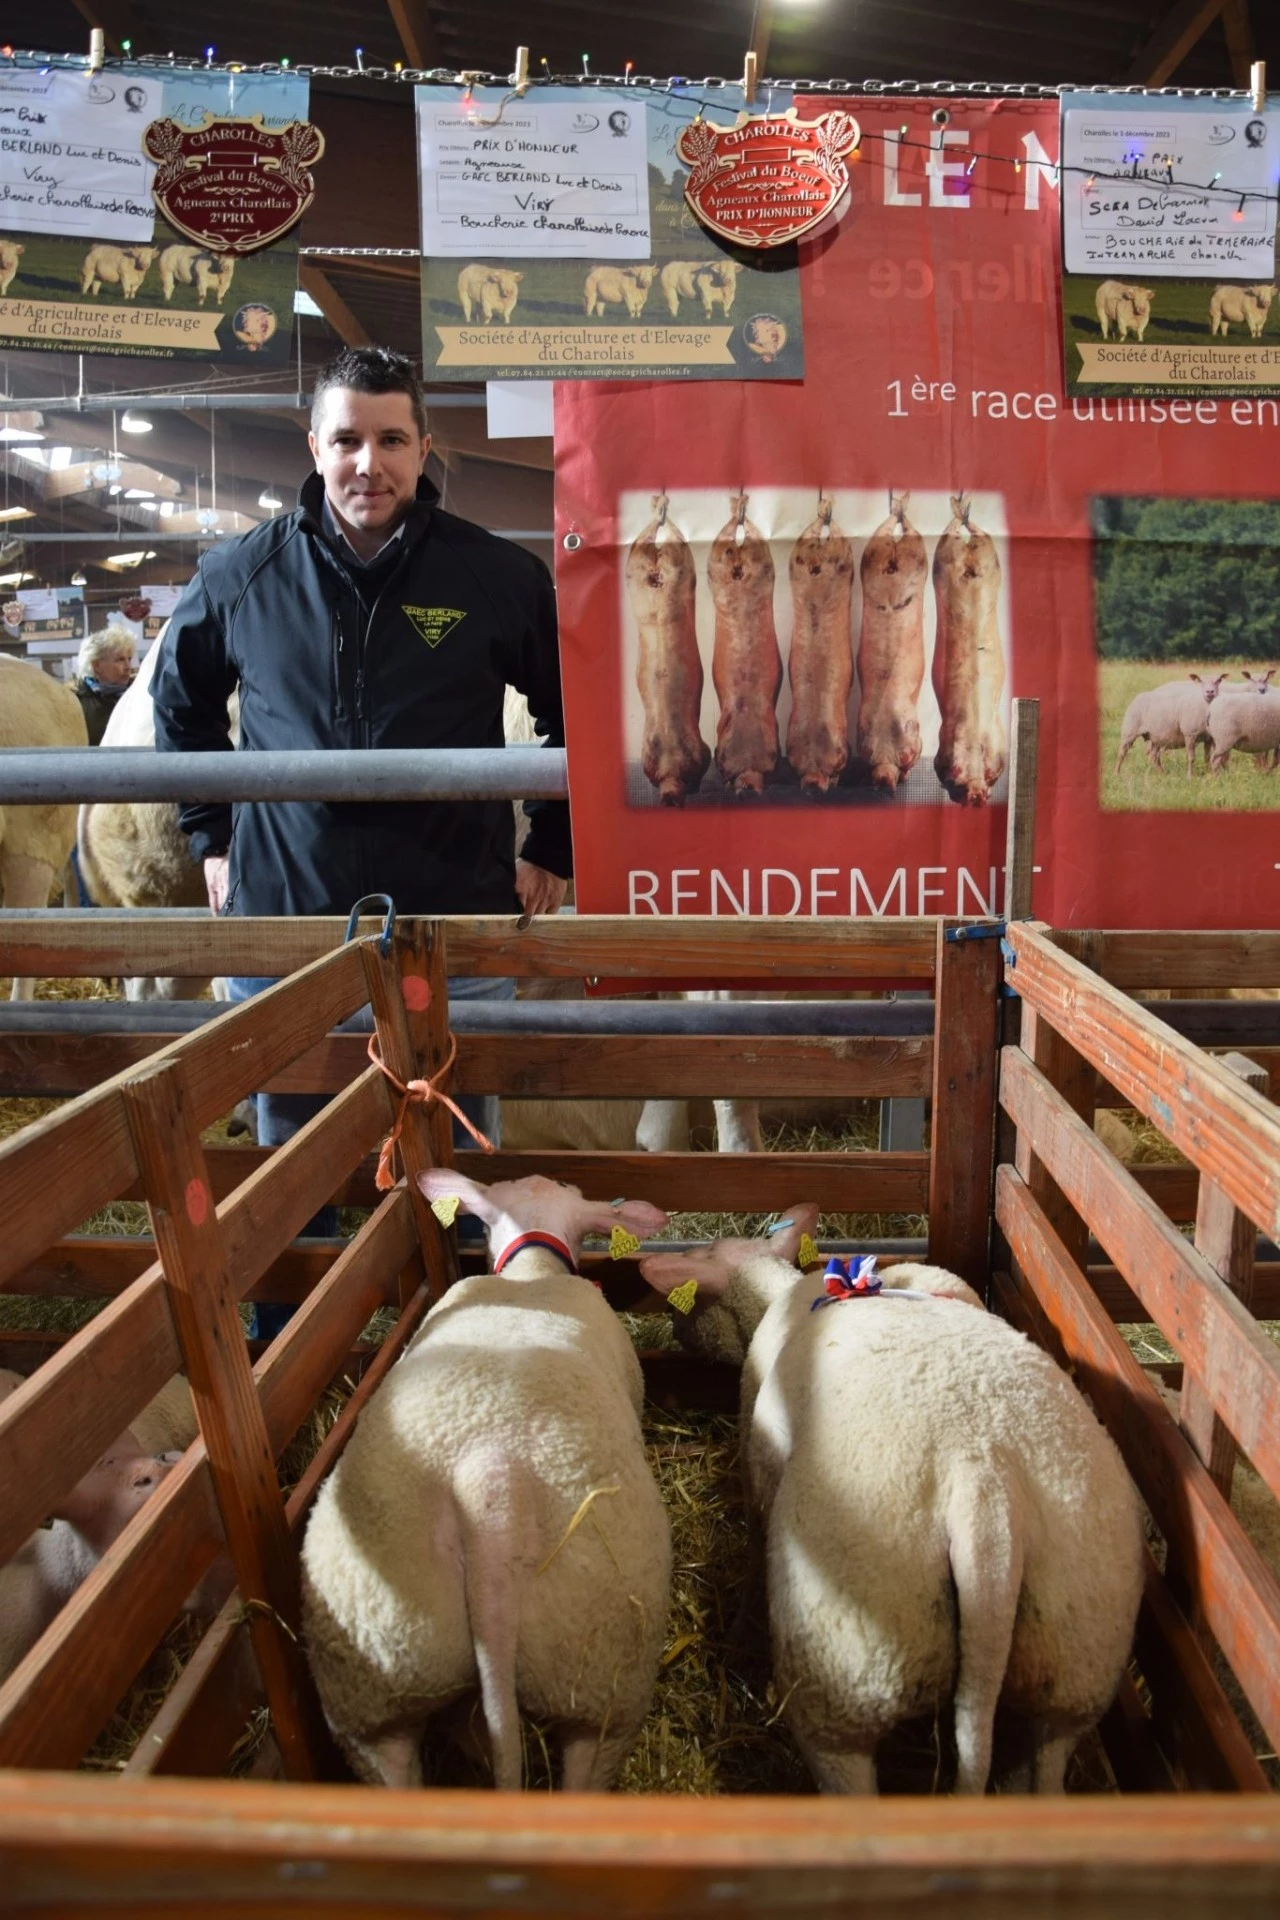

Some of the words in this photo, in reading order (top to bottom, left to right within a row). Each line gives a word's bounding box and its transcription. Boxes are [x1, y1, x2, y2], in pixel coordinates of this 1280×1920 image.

[190, 129, 275, 148] CHAROLLES
[724, 125, 811, 146] CHAROLLES
[1125, 129, 1154, 137] décembre
[2, 140, 61, 156] BERLAND
[66, 146, 88, 158] Luc
[92, 150, 105, 160] et
[108, 151, 141, 166] Denis
[505, 139, 579, 154] D'HONNEUR
[882, 129, 971, 208] LE
[180, 170, 224, 194] Festival
[228, 170, 244, 181] du
[462, 172, 491, 182] GAEC
[497, 172, 550, 183] BERLAND
[556, 175, 573, 187] Luc
[576, 177, 589, 188] et
[592, 179, 622, 191] Denis
[712, 167, 758, 192] Festival
[761, 165, 778, 176] du
[174, 198, 226, 210] Agneaux
[230, 198, 292, 209] Charollais
[707, 194, 760, 207] Agneaux
[763, 190, 826, 202] Charollais
[461, 216, 528, 229] Boucherie
[716, 209, 743, 221] PRIX
[747, 206, 813, 220] D'HONNEUR
[1116, 215, 1165, 227] David
[12, 304, 108, 324] d'Agriculture
[112, 311, 127, 323] et
[131, 313, 201, 331] d'Elevage
[28, 321, 46, 334] du
[51, 323, 122, 339] Charolais
[459, 331, 514, 345] Société
[519, 331, 619, 349] d'Agriculture
[622, 334, 636, 344] et
[641, 331, 711, 349] d'Elevage
[538, 346, 558, 360] du
[562, 346, 635, 361] Charolais
[1097, 348, 1147, 363] Société
[1151, 349, 1240, 367] d'Agriculture
[1244, 353, 1257, 364] et
[1169, 365, 1187, 380] du
[1191, 366, 1256, 381] Charolais
[972, 391, 1058, 419] race
[628, 866, 1042, 916] RENDEMEN
